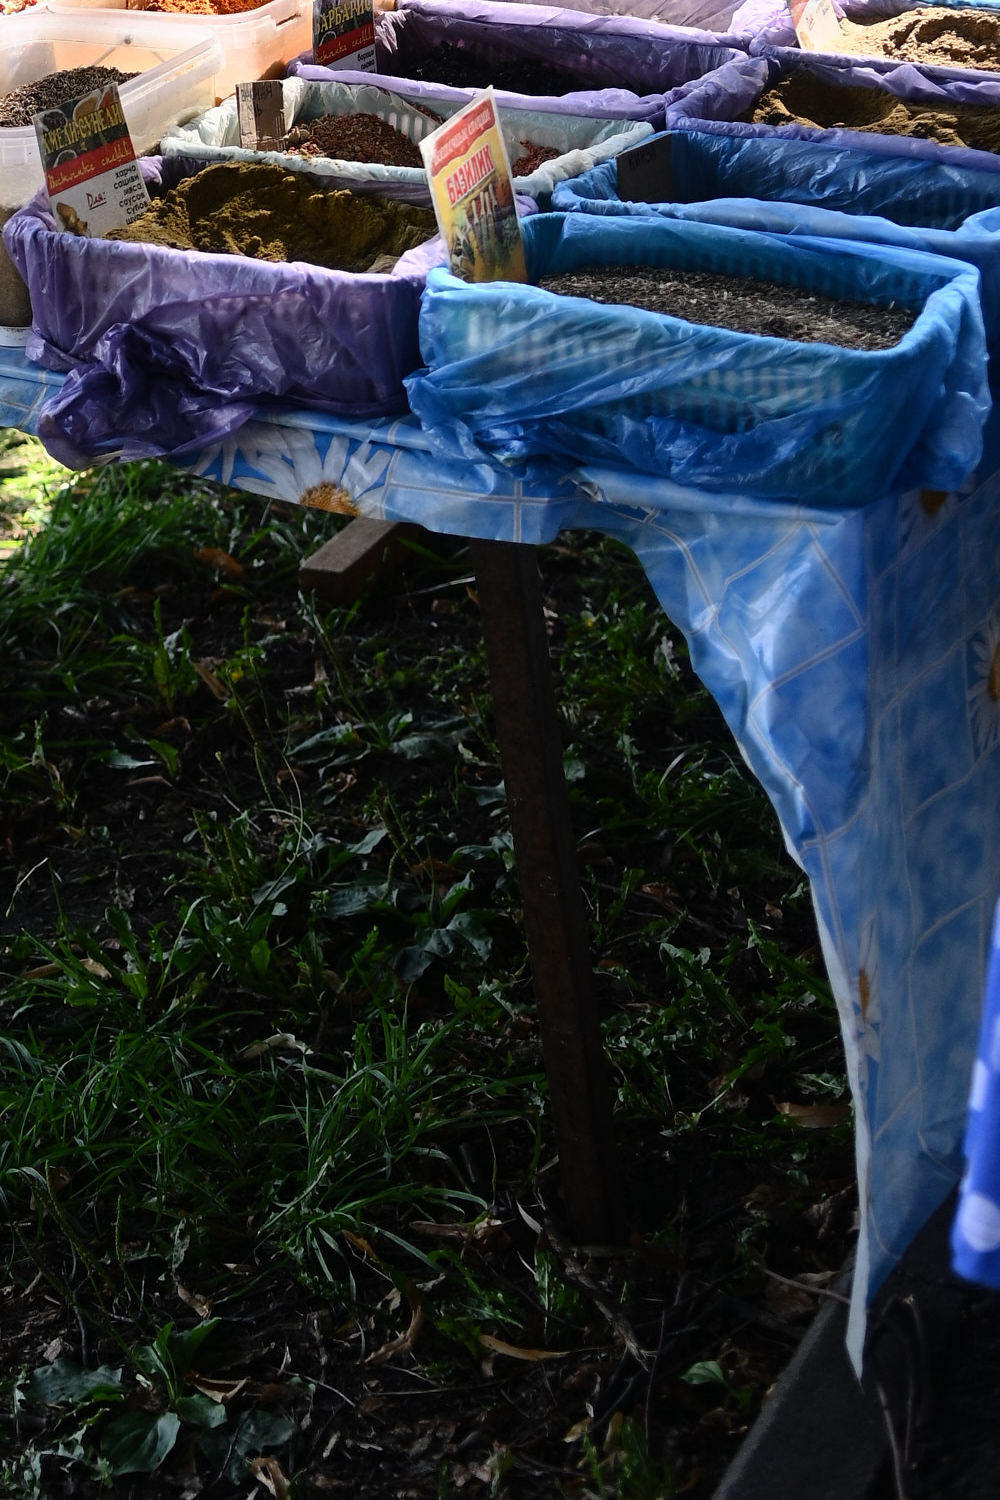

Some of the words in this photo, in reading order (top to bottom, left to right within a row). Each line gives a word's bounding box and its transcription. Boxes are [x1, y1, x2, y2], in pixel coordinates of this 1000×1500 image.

[115, 165, 137, 178] харчо
[446, 143, 495, 206] БАЗИЛИК
[113, 175, 140, 190] сациви
[119, 192, 146, 208] соусов
[126, 201, 149, 215] супов
